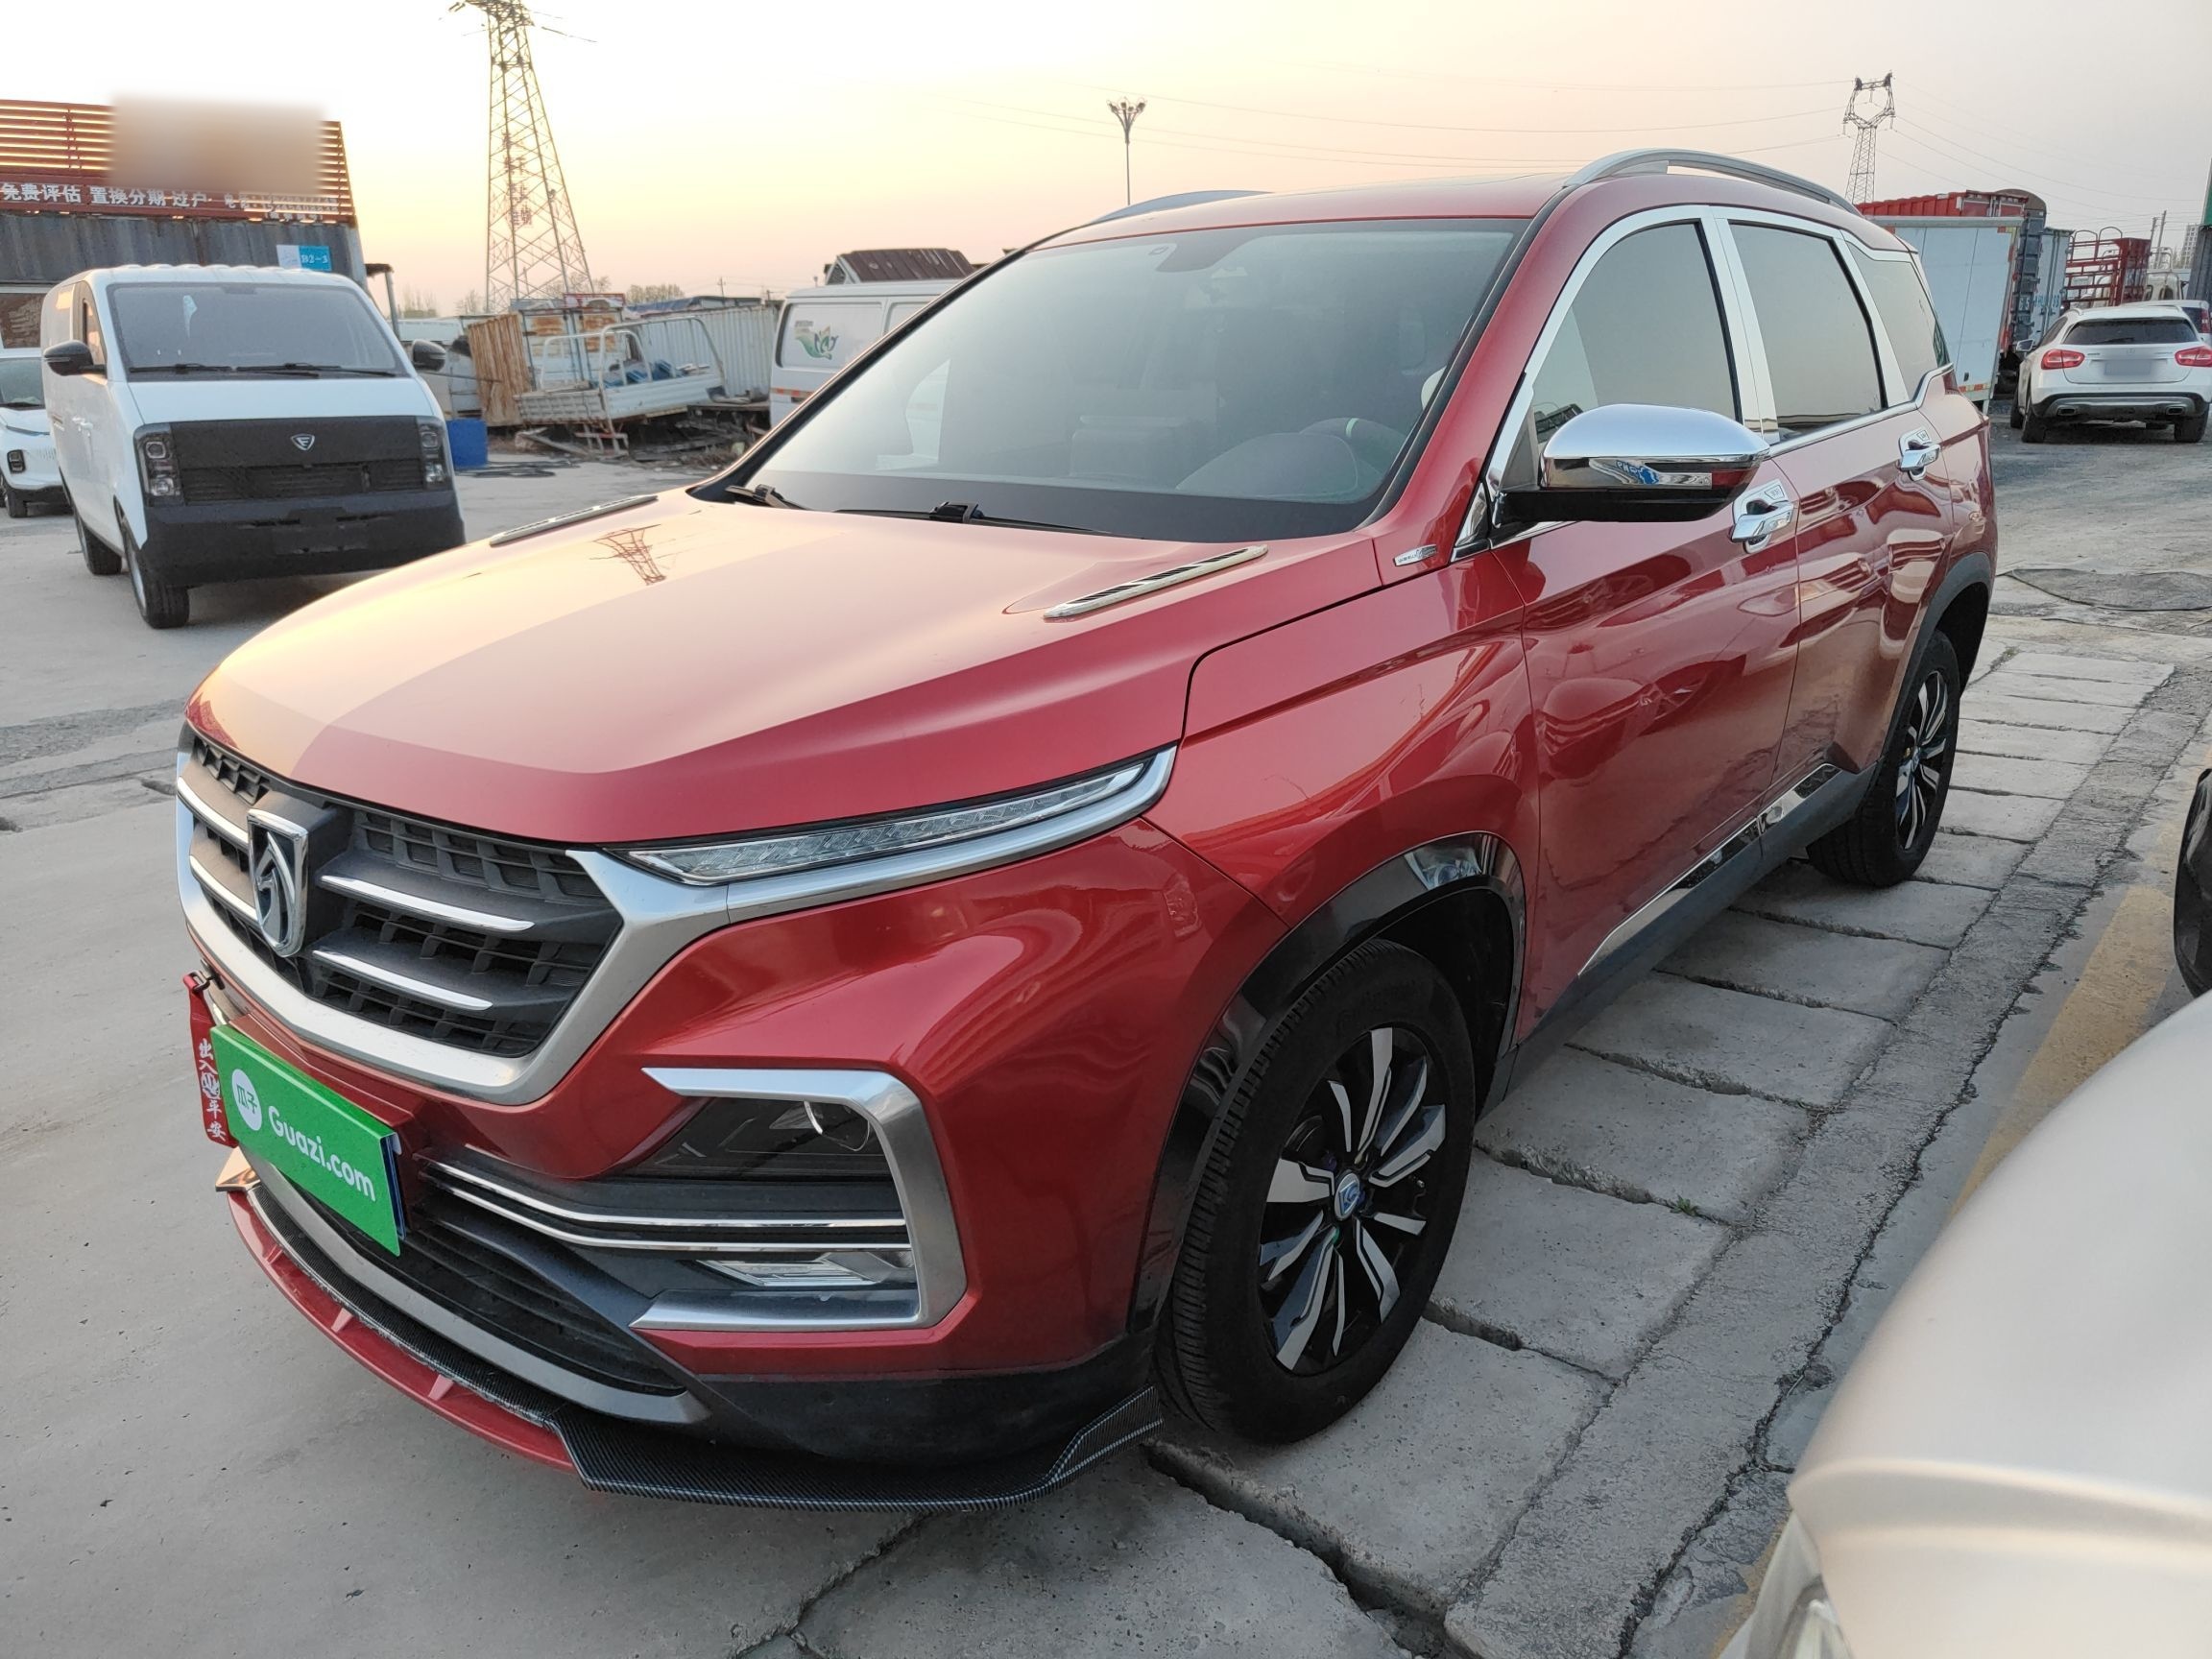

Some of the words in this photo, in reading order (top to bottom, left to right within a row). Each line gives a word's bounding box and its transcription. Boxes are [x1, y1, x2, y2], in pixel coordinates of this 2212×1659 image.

[1, 182, 81, 204] 免费评估
[90, 185, 168, 206] 置换分期
[171, 190, 207, 207] 过户
[268, 1106, 376, 1202] Guazi.com
